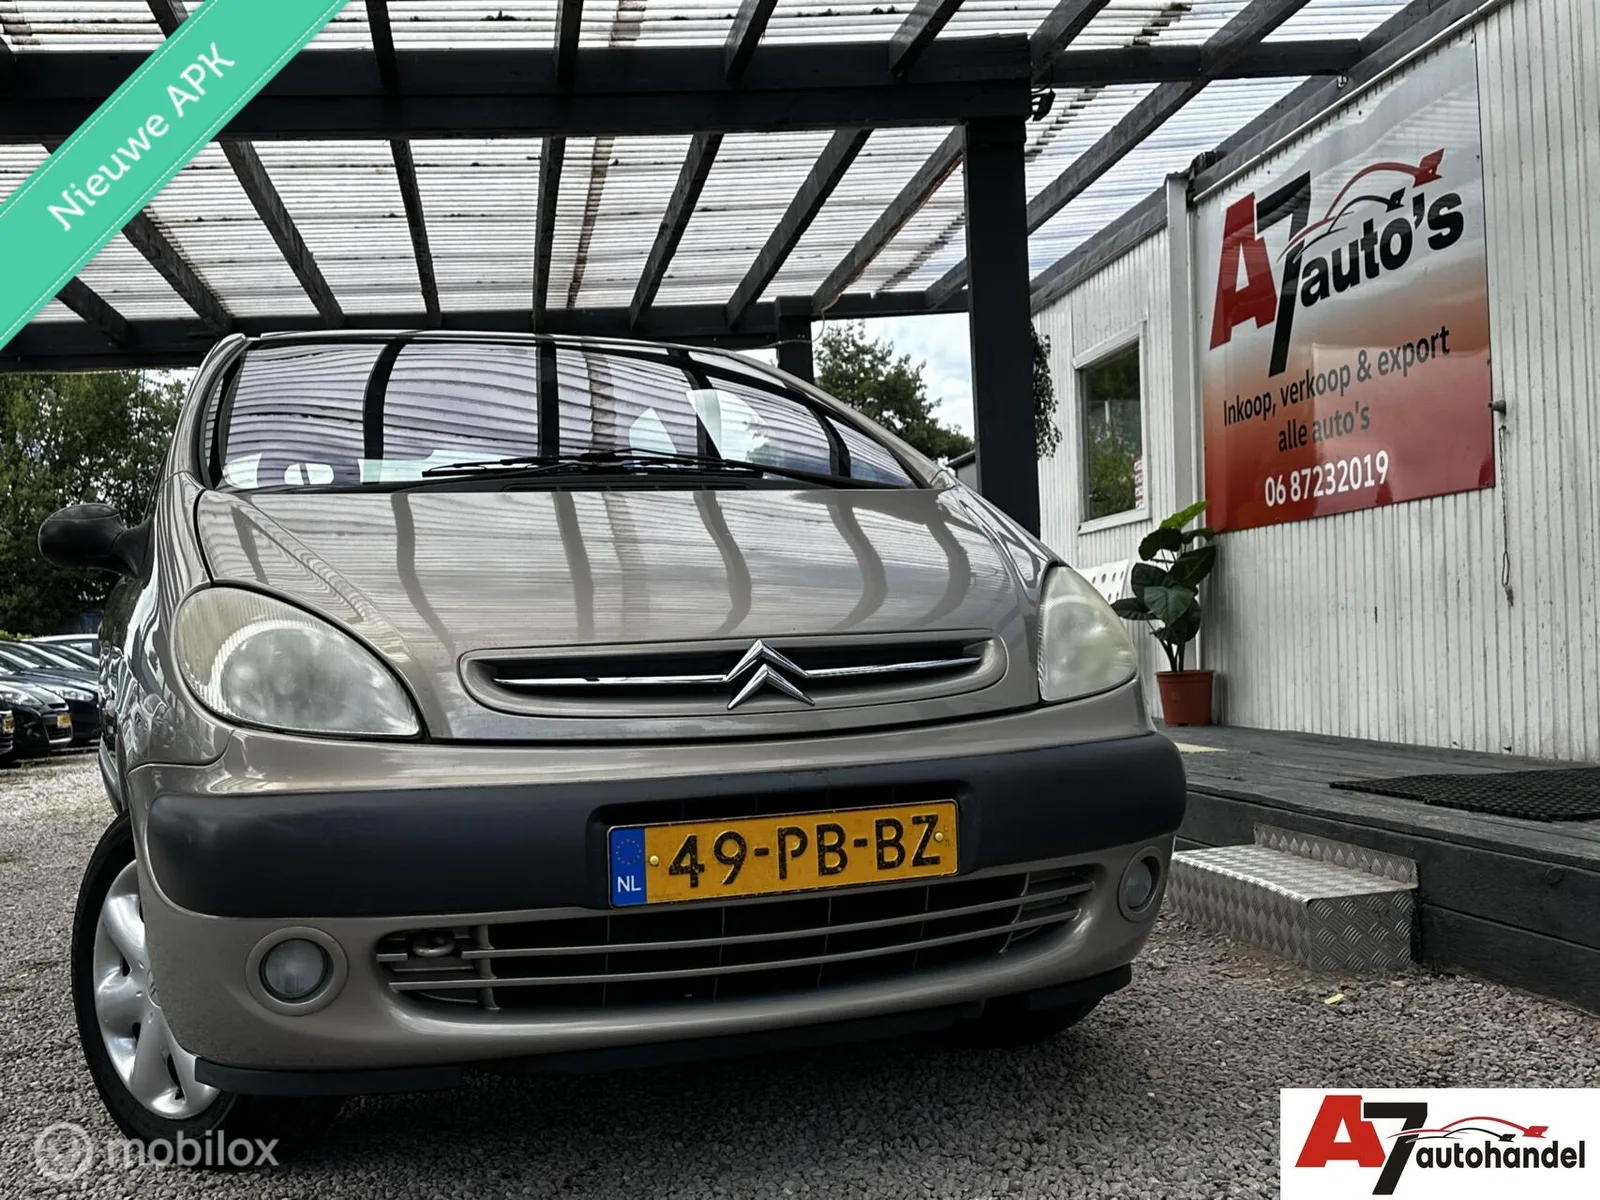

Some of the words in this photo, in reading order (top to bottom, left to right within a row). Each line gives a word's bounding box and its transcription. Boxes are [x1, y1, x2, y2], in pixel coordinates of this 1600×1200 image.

[1209, 170, 1311, 377] A7
[1300, 191, 1464, 307] auto's
[1224, 391, 1276, 426] Inkoop,
[1280, 364, 1351, 407] verkoop
[1356, 349, 1372, 382] &
[1377, 326, 1450, 377] export
[1278, 419, 1307, 452] alle
[1312, 400, 1370, 443] auto's
[1264, 474, 1286, 507] 06
[1290, 450, 1389, 502] 87232019
[668, 813, 941, 888] 49-PB-BZ
[617, 875, 642, 893] NL
